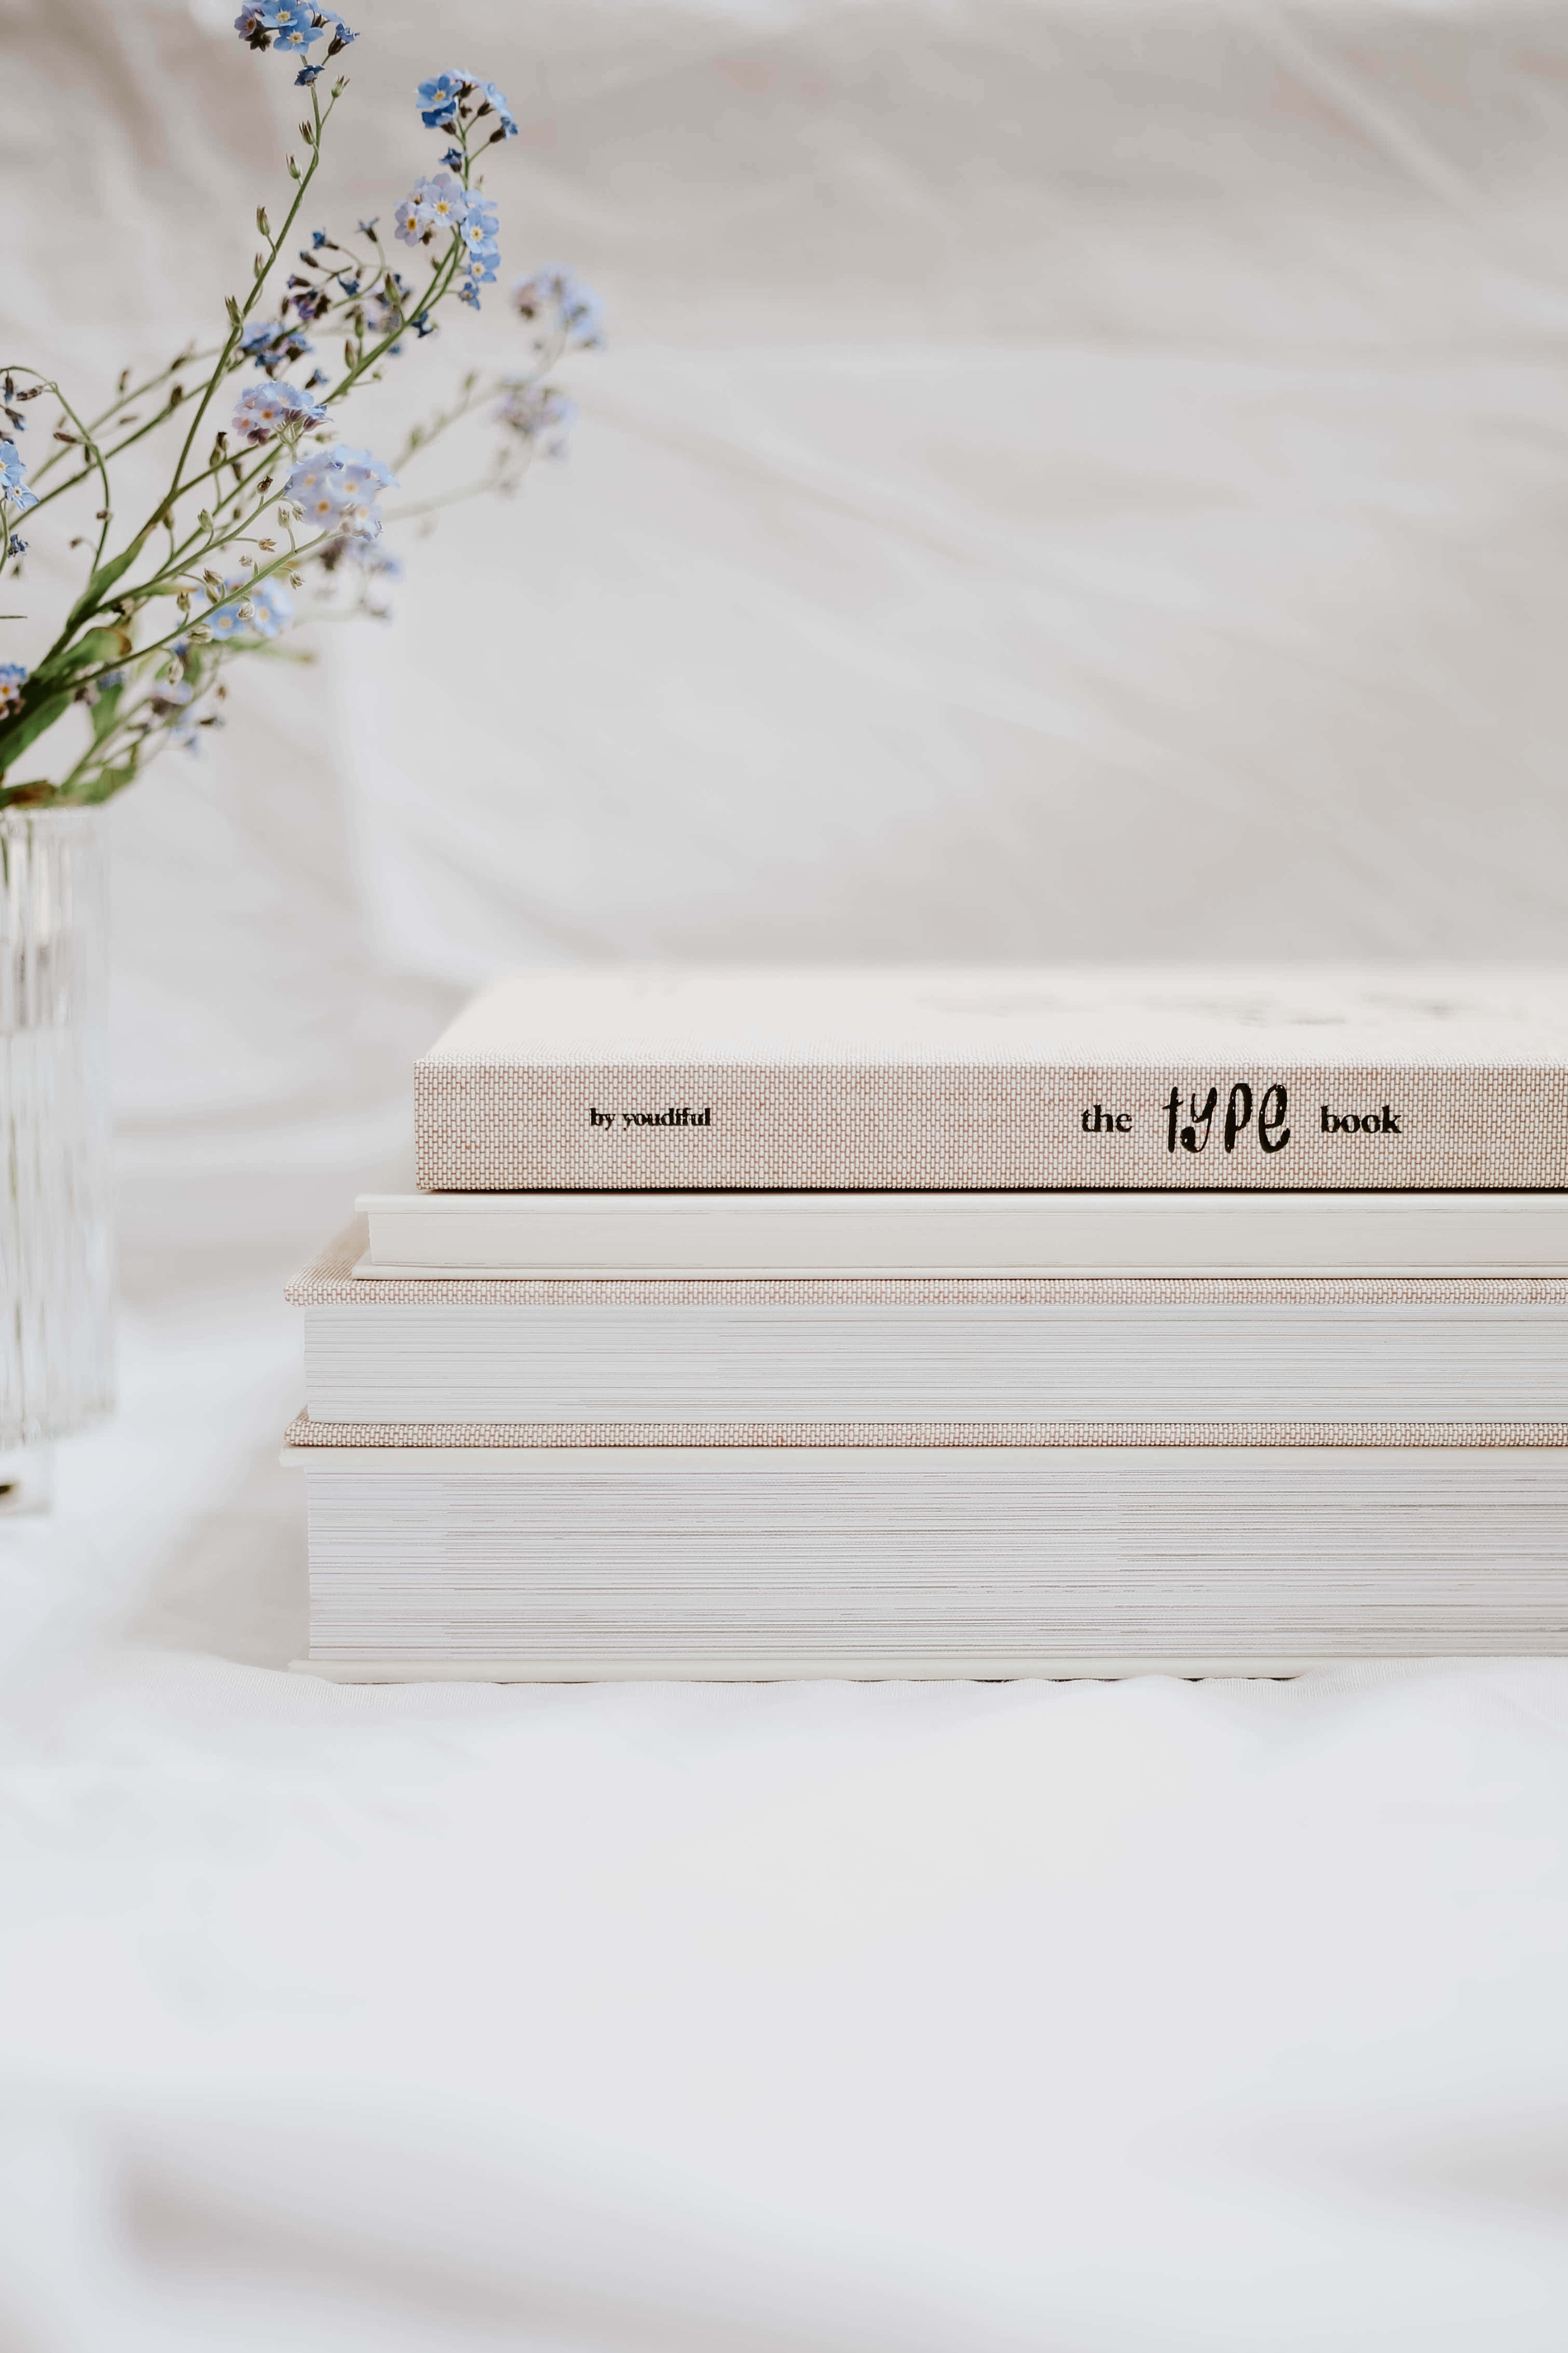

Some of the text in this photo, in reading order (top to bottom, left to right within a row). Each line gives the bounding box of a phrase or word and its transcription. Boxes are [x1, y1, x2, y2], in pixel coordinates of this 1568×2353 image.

[590, 1107, 616, 1131] by
[1081, 1082, 1402, 1154] the type book
